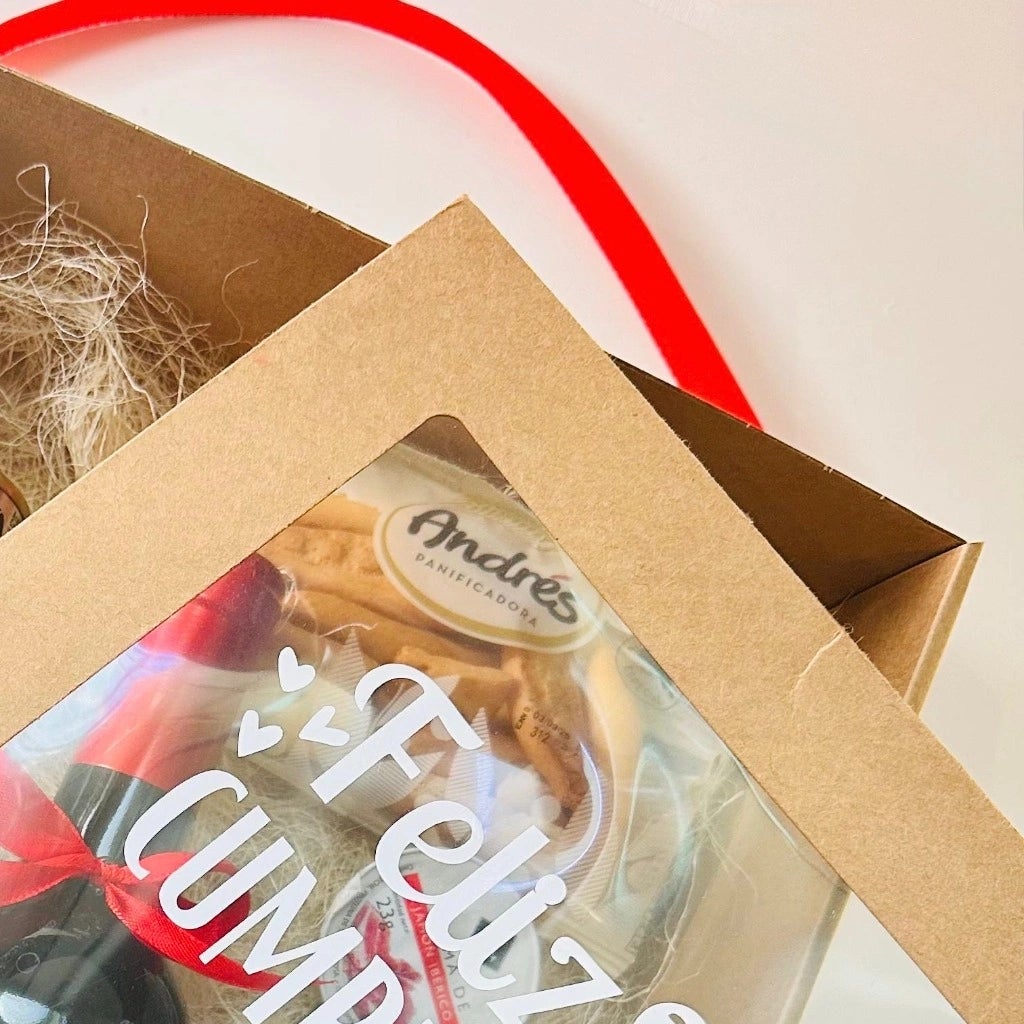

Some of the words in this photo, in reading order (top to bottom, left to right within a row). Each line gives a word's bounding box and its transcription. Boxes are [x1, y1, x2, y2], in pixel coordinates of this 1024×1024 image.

[407, 509, 577, 624] Andrés
[415, 553, 537, 628] PANIFICADORA
[376, 897, 395, 933] 23g
[453, 987, 471, 1012] DE
